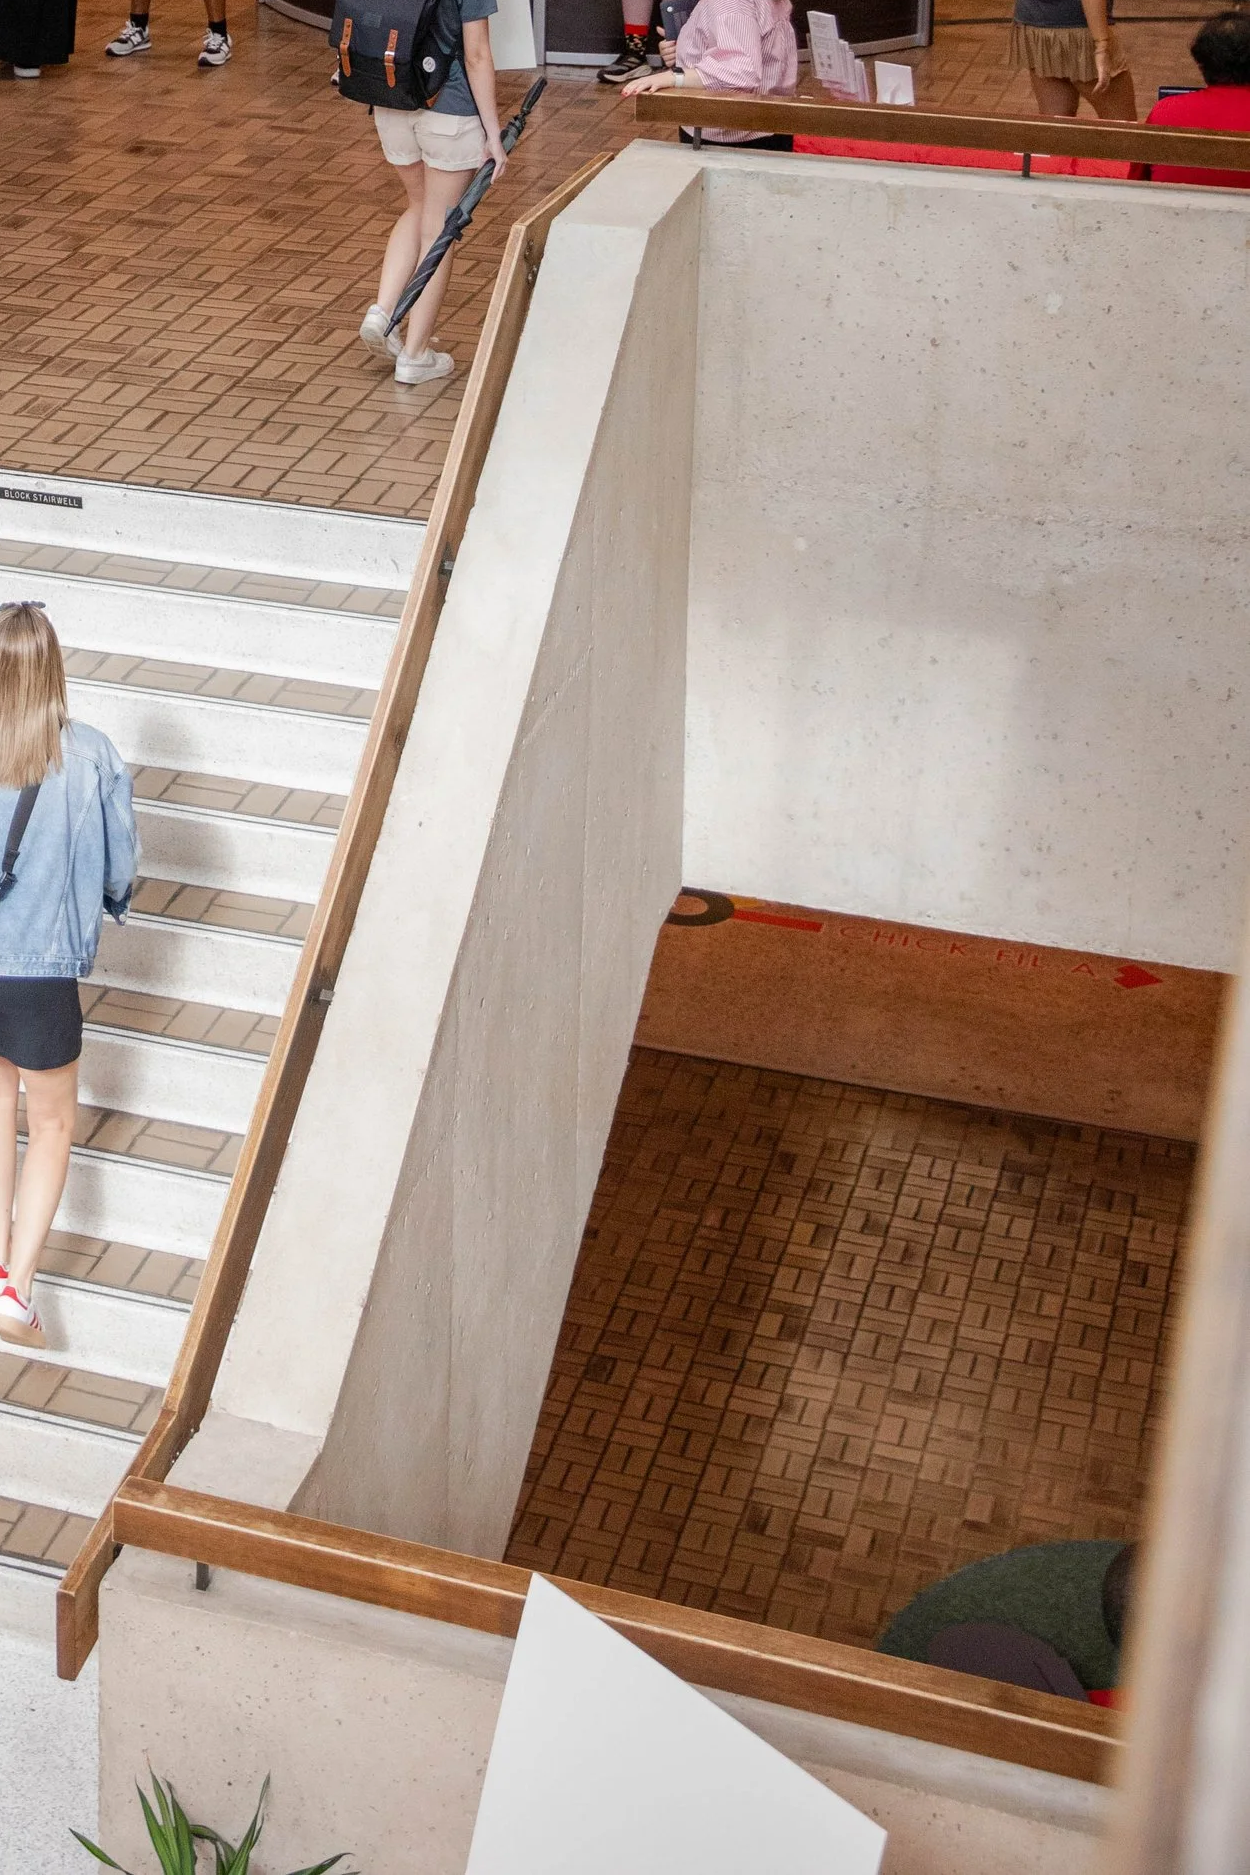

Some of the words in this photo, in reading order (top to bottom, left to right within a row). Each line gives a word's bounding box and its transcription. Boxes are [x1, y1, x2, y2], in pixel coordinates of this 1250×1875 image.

[4, 490, 31, 500] BLOCK
[33, 492, 79, 507] STAIRWELL
[839, 926, 969, 957] CHICK
[995, 948, 1043, 968] FIL
[1071, 962, 1096, 978] A
